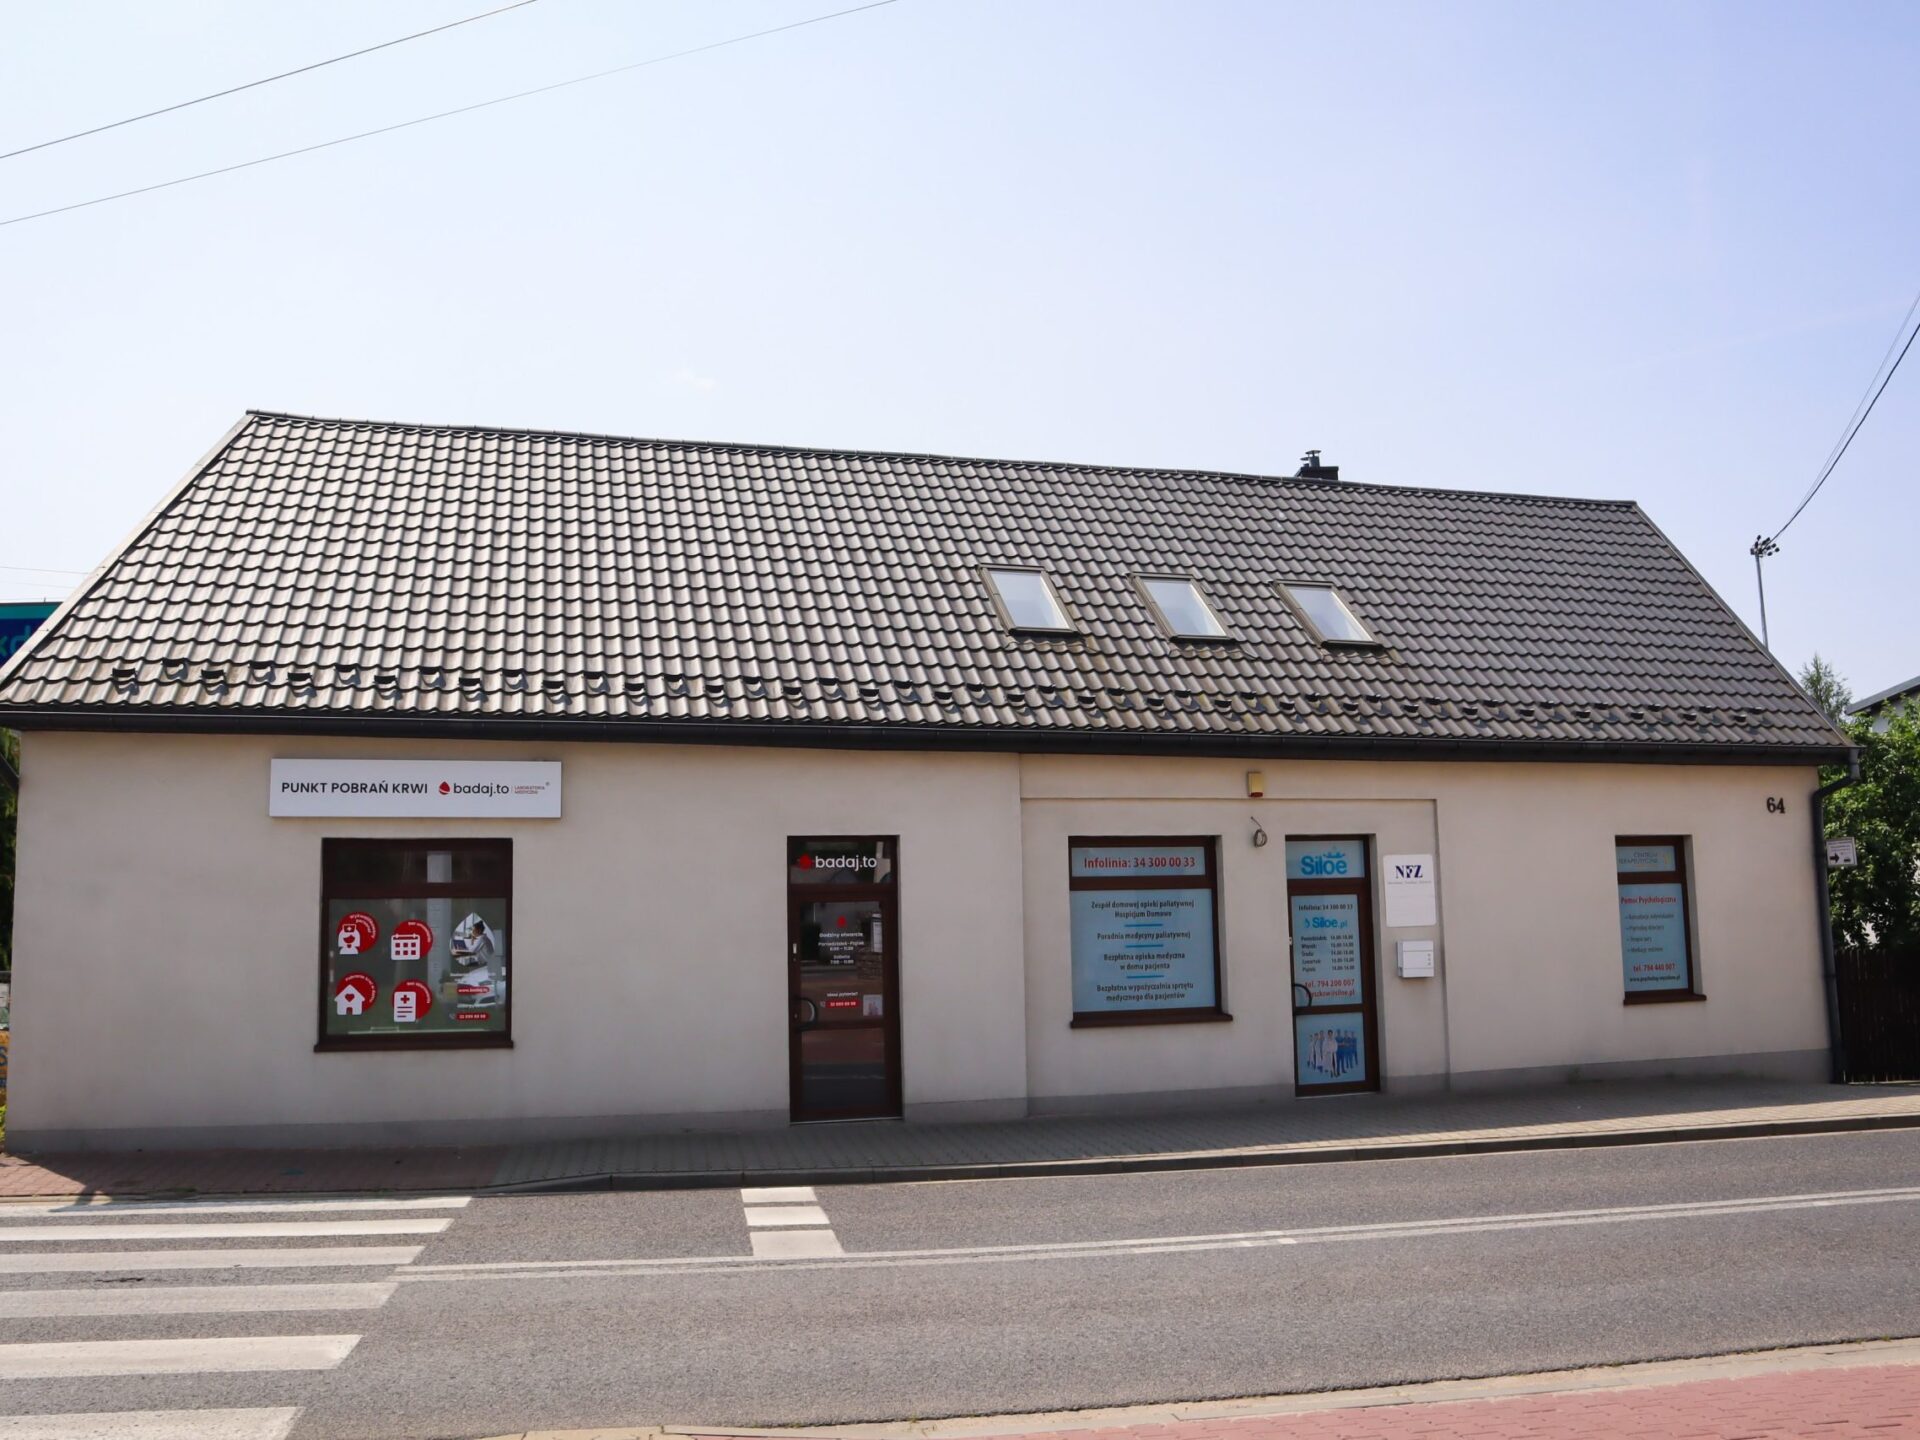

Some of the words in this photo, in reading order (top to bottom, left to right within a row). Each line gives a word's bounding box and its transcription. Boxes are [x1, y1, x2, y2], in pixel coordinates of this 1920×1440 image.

[281, 782, 328, 793] PUNKT
[331, 780, 389, 794] POBRAŃ
[392, 783, 428, 794] KRWI
[453, 783, 510, 797] badaj.to
[1766, 797, 1786, 814] 64
[815, 854, 877, 872] badaj.to
[1084, 857, 1131, 869] Infolinia:
[1133, 857, 1146, 868] 34
[1148, 857, 1167, 868] 300
[1169, 857, 1181, 868] 00
[1183, 857, 1196, 867] 33
[1301, 855, 1348, 875] Siloe
[1395, 865, 1423, 879] NFZ
[1112, 901, 1140, 909] domowej
[1140, 900, 1158, 909] opieki
[1160, 900, 1194, 908] paliatywnej
[1156, 932, 1190, 940] paliatywnej
[1104, 954, 1134, 962] Bezpłatna
[1135, 953, 1155, 962] opieka
[1156, 952, 1186, 960] medyczna
[1144, 963, 1170, 971] pacjenta
[1096, 984, 1127, 992] Bezpłatna
[1128, 982, 1170, 992] wypożyczalnia
[1172, 982, 1194, 990] sprzętu
[1106, 994, 1143, 1002] medycznego
[1154, 992, 1186, 1001] pacjentów
